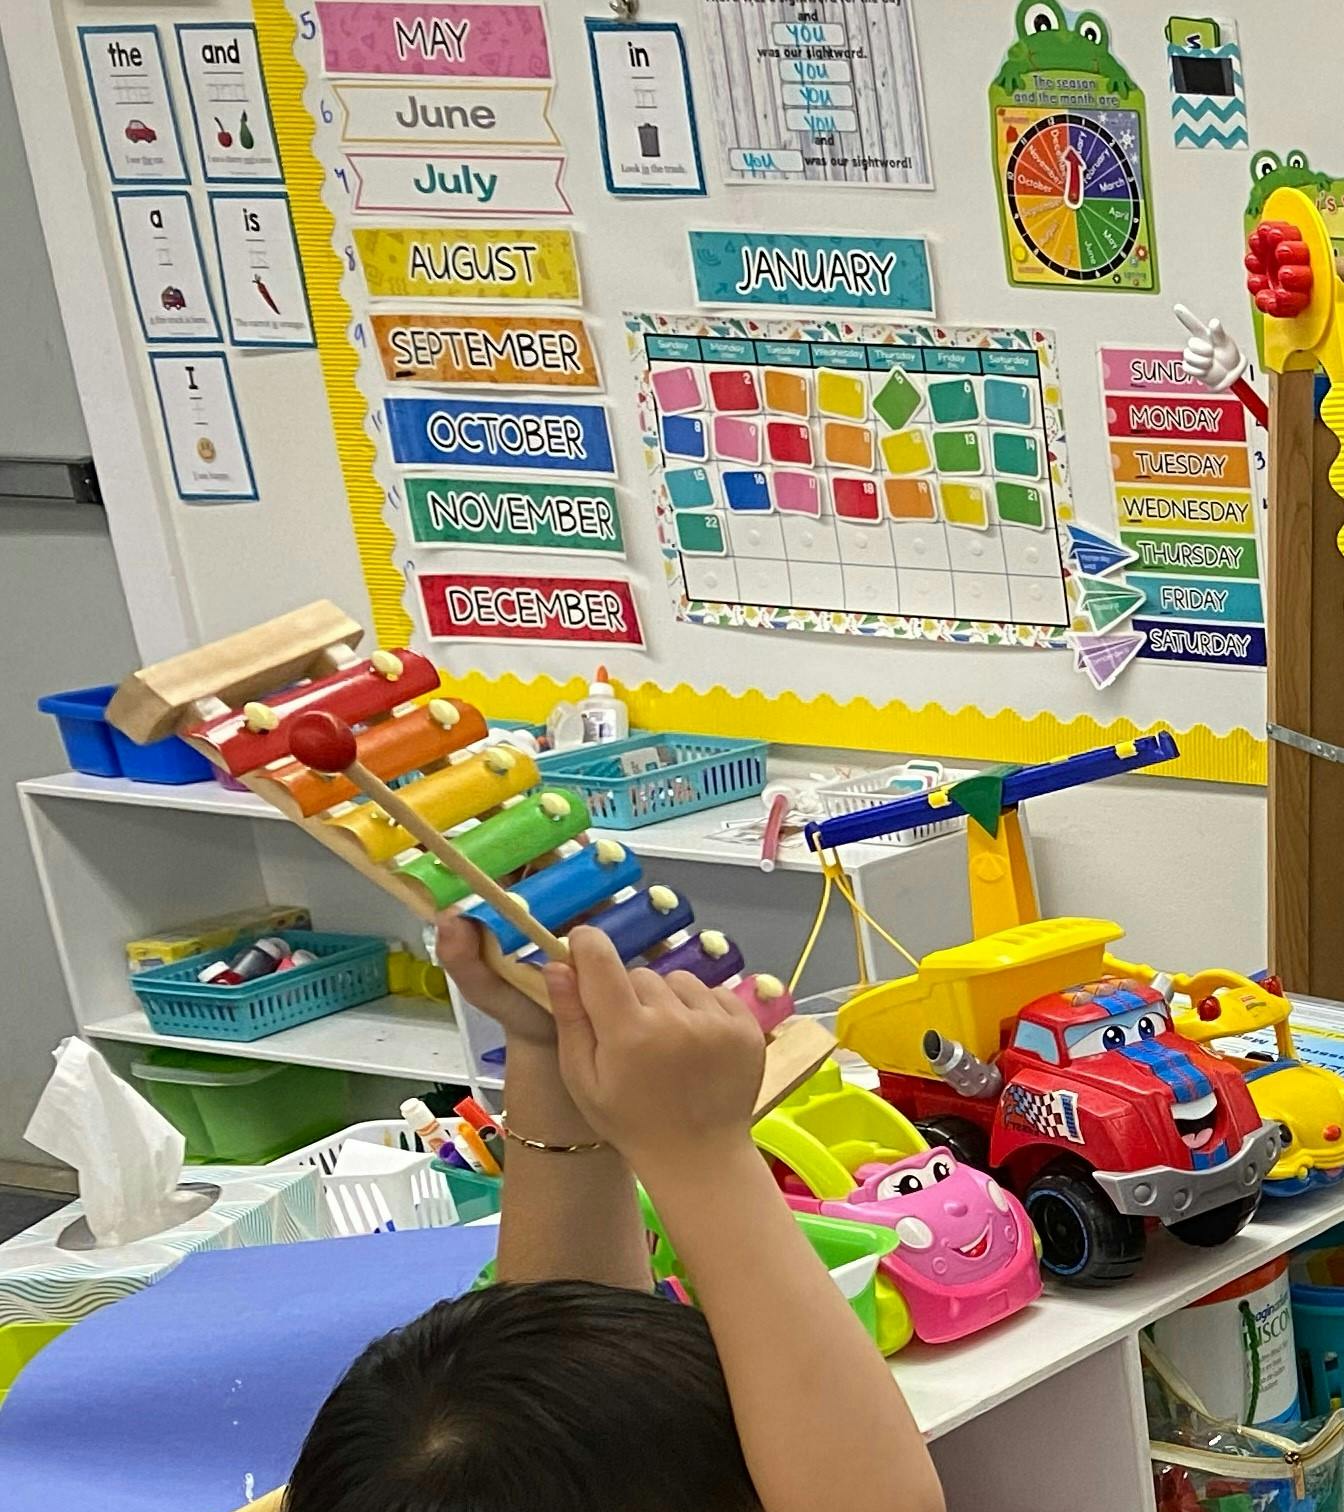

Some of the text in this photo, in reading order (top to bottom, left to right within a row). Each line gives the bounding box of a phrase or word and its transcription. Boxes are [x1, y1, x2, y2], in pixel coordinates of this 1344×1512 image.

[301, 11, 316, 40] 5
[395, 20, 468, 58] MAY
[107, 41, 143, 67] the
[202, 38, 241, 64] and
[627, 41, 650, 68] in
[757, 48, 780, 58] was
[784, 48, 802, 58] our
[1033, 76, 1096, 89] The season
[1014, 92, 1118, 106] and the month are
[320, 100, 333, 124] 6
[396, 96, 496, 129] June
[805, 156, 827, 166] was
[830, 157, 847, 167] our
[414, 164, 498, 202] July
[150, 209, 163, 229] a
[242, 208, 261, 232] is
[345, 245, 356, 271] 8
[410, 245, 537, 282] AUGUST
[738, 248, 895, 294] JANUARY
[354, 323, 367, 348] 9
[657, 339, 690, 350] Sunday
[391, 330, 581, 372] SEPTEMBER
[709, 343, 745, 354] Monday
[765, 345, 801, 357] Tuesday
[875, 350, 915, 362] Thursday
[937, 352, 966, 364] Friday
[989, 354, 1030, 366] Saturday
[185, 366, 199, 390] I
[743, 372, 751, 385] 2
[1131, 360, 1200, 383] SUND
[964, 382, 971, 393] 6
[1021, 387, 1027, 398] 7
[694, 421, 701, 432] 8
[1130, 408, 1221, 432] MONDAY
[430, 414, 584, 457] OCTOBER
[749, 426, 756, 436] 9
[965, 434, 975, 445] 13
[1026, 438, 1035, 450] 14
[1136, 452, 1227, 477] TUESDAY
[1254, 451, 1266, 470] 3
[694, 469, 705, 481] 15
[754, 473, 764, 484] 16
[863, 482, 874, 494] 18
[918, 482, 928, 493] 19
[1027, 489, 1037, 501] 21
[431, 494, 615, 540] NOVEMBER
[1122, 497, 1249, 523] WEDNESDAY
[704, 516, 718, 529] 22
[1139, 542, 1243, 568] THURSDAY
[450, 589, 625, 630] DECEMBER
[1161, 587, 1227, 611] FRIDAY
[1150, 629, 1251, 658] SATURDAY
